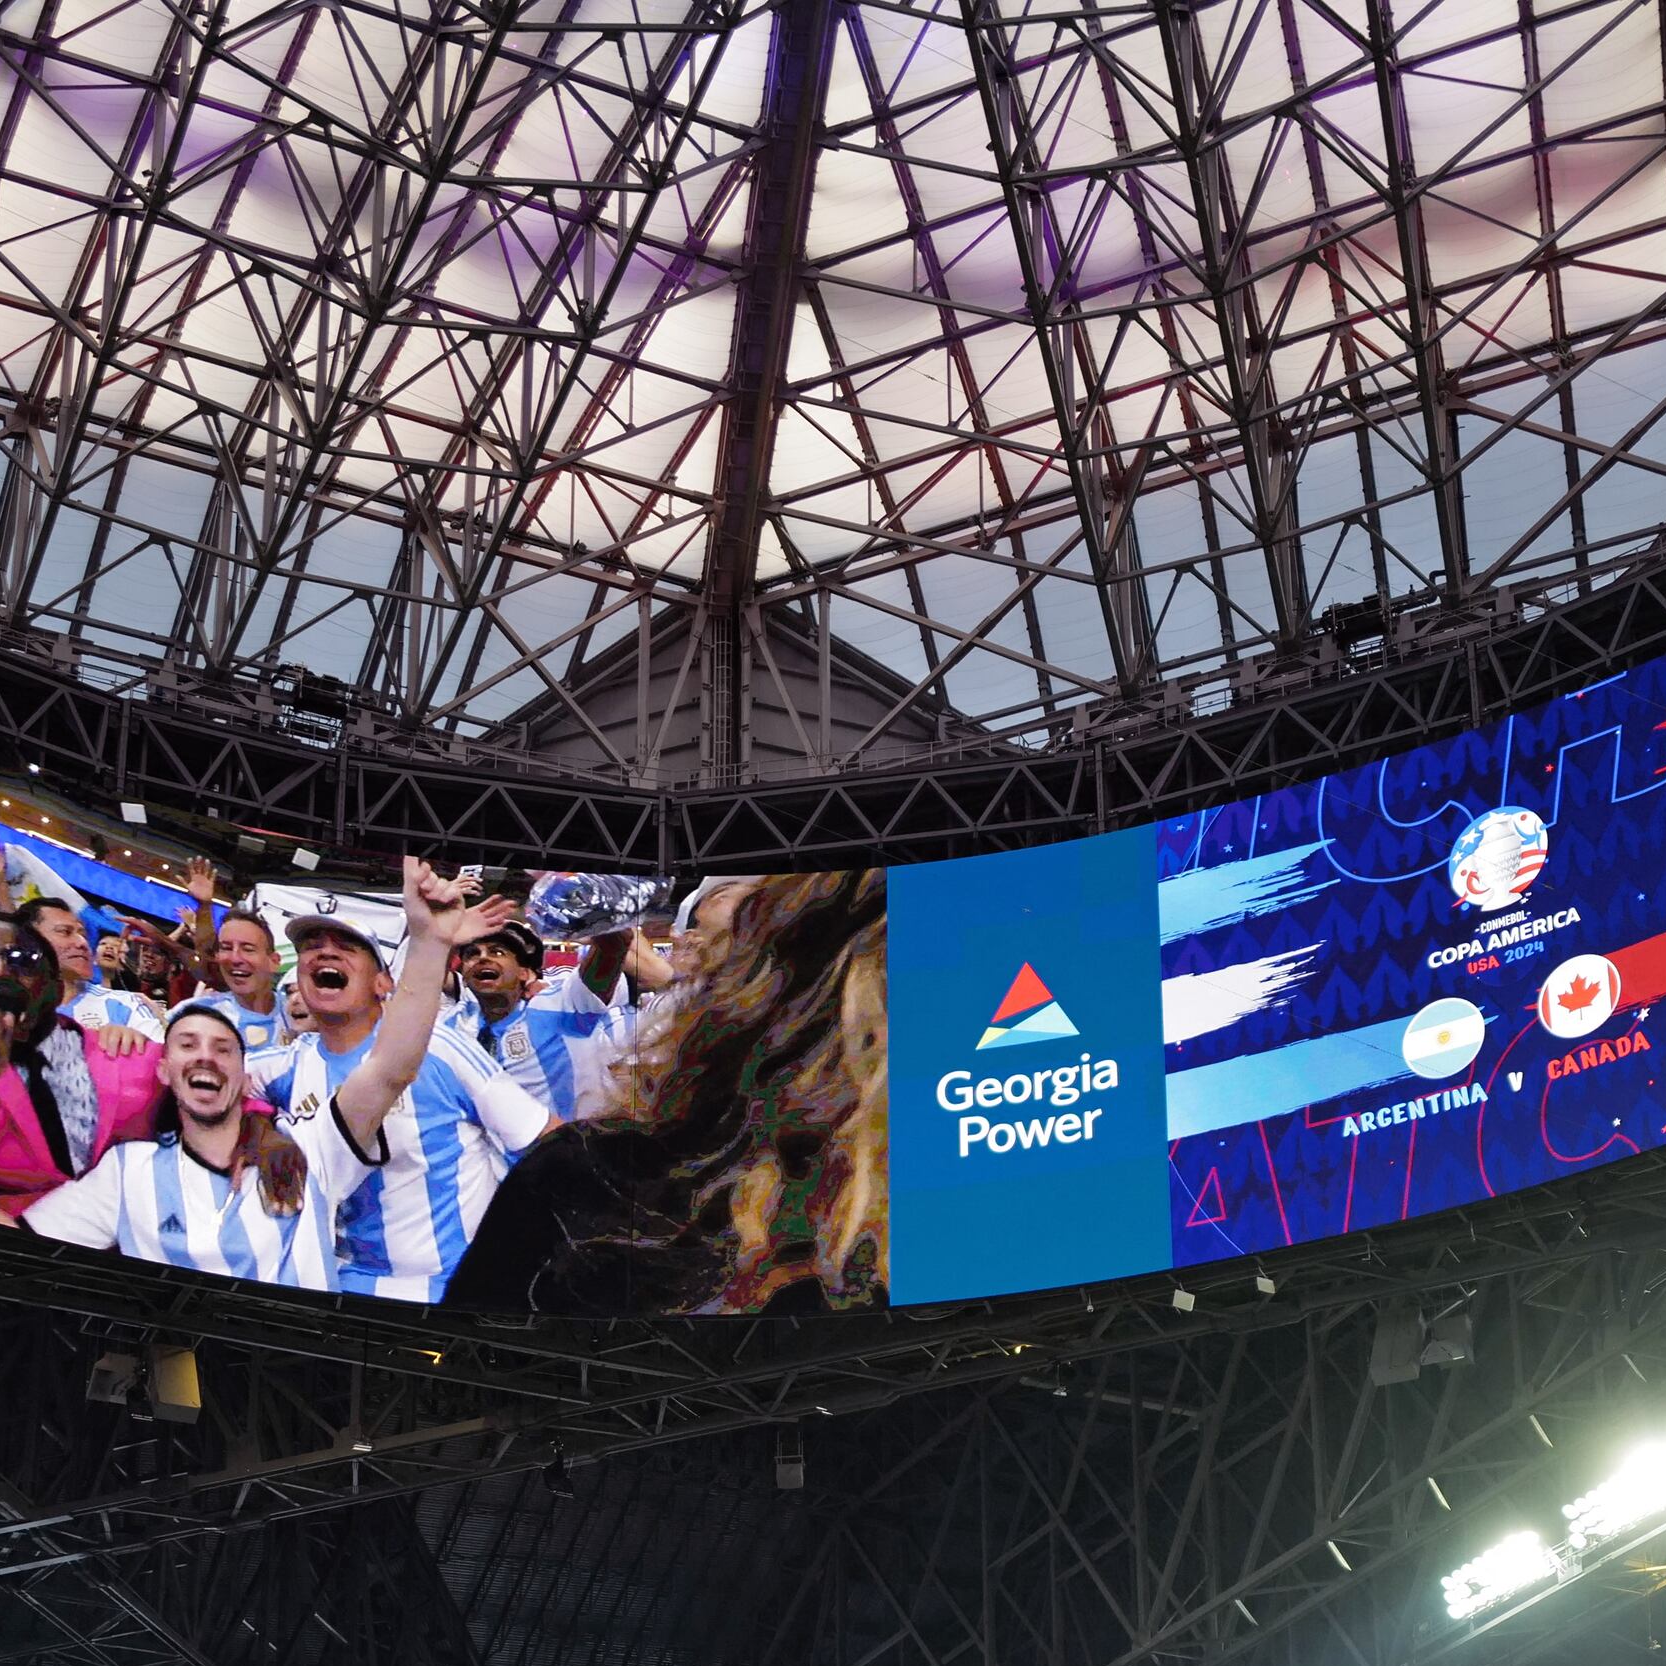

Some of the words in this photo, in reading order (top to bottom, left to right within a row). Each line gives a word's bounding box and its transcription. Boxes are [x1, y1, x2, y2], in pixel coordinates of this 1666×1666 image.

[1427, 941, 1485, 969] COPA
[1486, 907, 1581, 953] AMERICA
[1467, 956, 1501, 975] USA
[1504, 941, 1545, 964] 2024
[936, 1052, 1120, 1113] Georgia
[1547, 1031, 1652, 1081] CANADA
[958, 1110, 1104, 1158] Power
[1341, 1082, 1489, 1138] ARGENTINA
